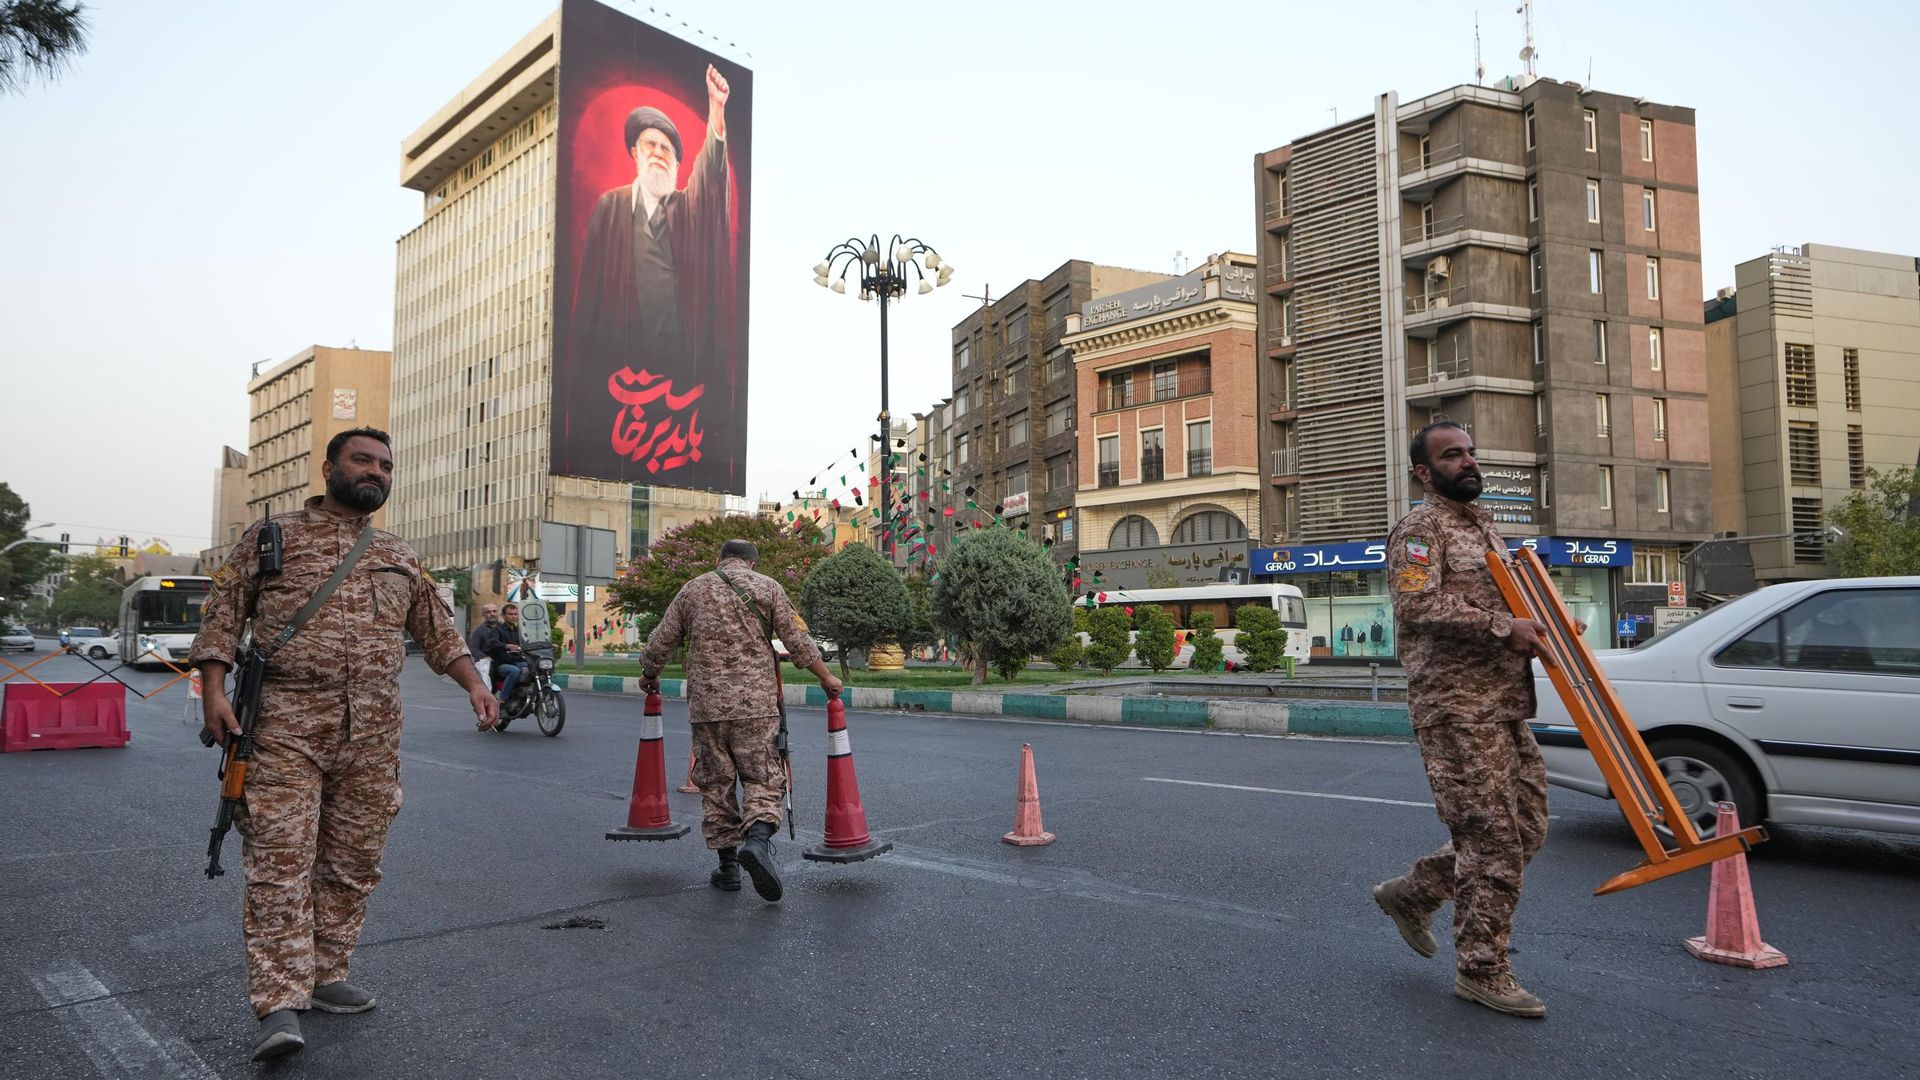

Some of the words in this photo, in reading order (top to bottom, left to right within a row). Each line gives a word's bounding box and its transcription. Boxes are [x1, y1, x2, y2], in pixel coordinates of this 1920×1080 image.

[1225, 267, 1255, 282] صرافی
[1162, 286, 1198, 306] صرافی
[1226, 283, 1255, 301] پارسه
[1090, 299, 1121, 314] PARSEH
[1133, 294, 1161, 311] پارسه
[1083, 308, 1129, 327] EXCHANGE
[1481, 469, 1511, 478] تخصصی
[1512, 470, 1531, 481] مرکز
[1502, 486, 1532, 495] ارتودنسی
[1265, 561, 1297, 572] GERAD
[1584, 554, 1610, 564] GERAD
